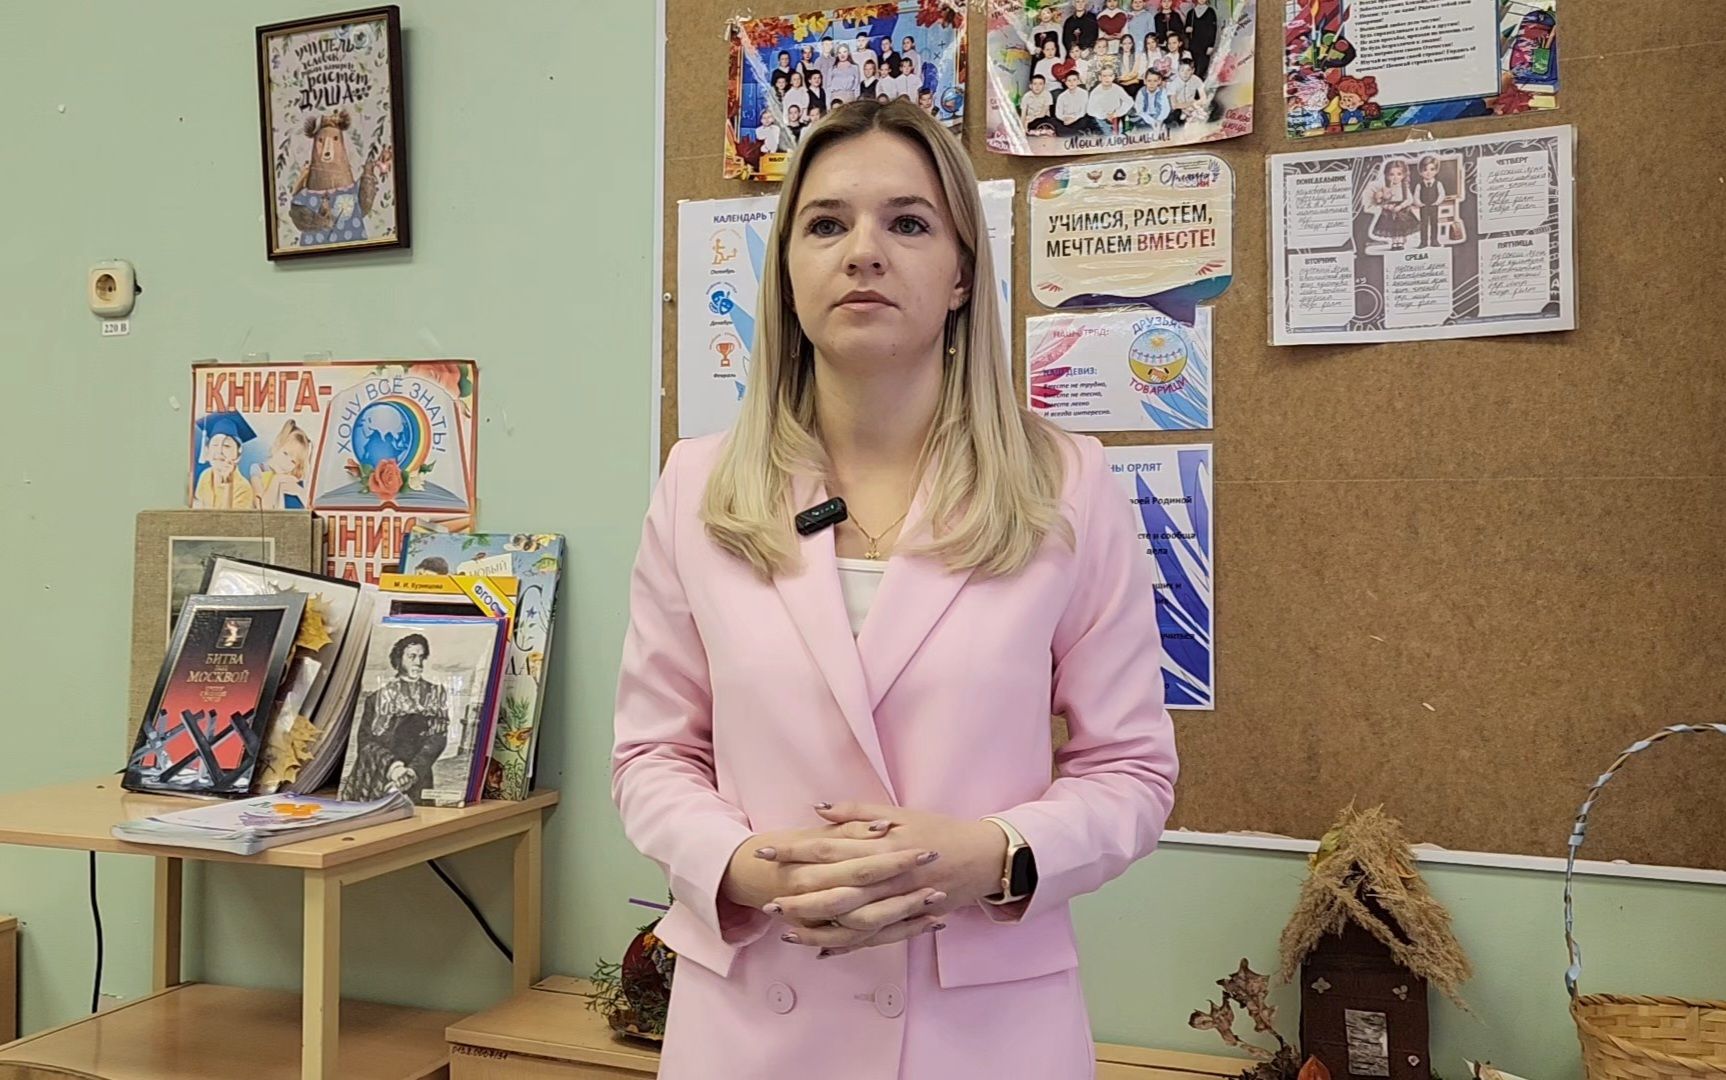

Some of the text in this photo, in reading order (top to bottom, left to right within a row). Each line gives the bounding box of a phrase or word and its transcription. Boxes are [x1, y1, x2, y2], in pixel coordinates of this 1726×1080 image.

[299, 83, 354, 111] ДУША
[713, 212, 767, 223] КАЛЕНДАРЬ
[1049, 202, 1213, 233] УЧИМСЯ, РАСТЁМ,
[1046, 229, 1216, 257] МЕЧТАЕМ ВМЕСТЕ!
[1405, 253, 1428, 261] СРЕДА
[104, 324, 118, 333] 220
[206, 371, 332, 413] КНИГА-
[1129, 376, 1186, 394] ТОВАРИЩИ
[337, 393, 361, 454] ХОЧУ
[409, 382, 447, 452] ЗНАТЬ!
[1127, 463, 1162, 472] ОРЛЯТ
[1152, 496, 1192, 504] Родиной
[205, 653, 244, 665] БИТВА
[186, 669, 250, 683] МОСКВОЙ
